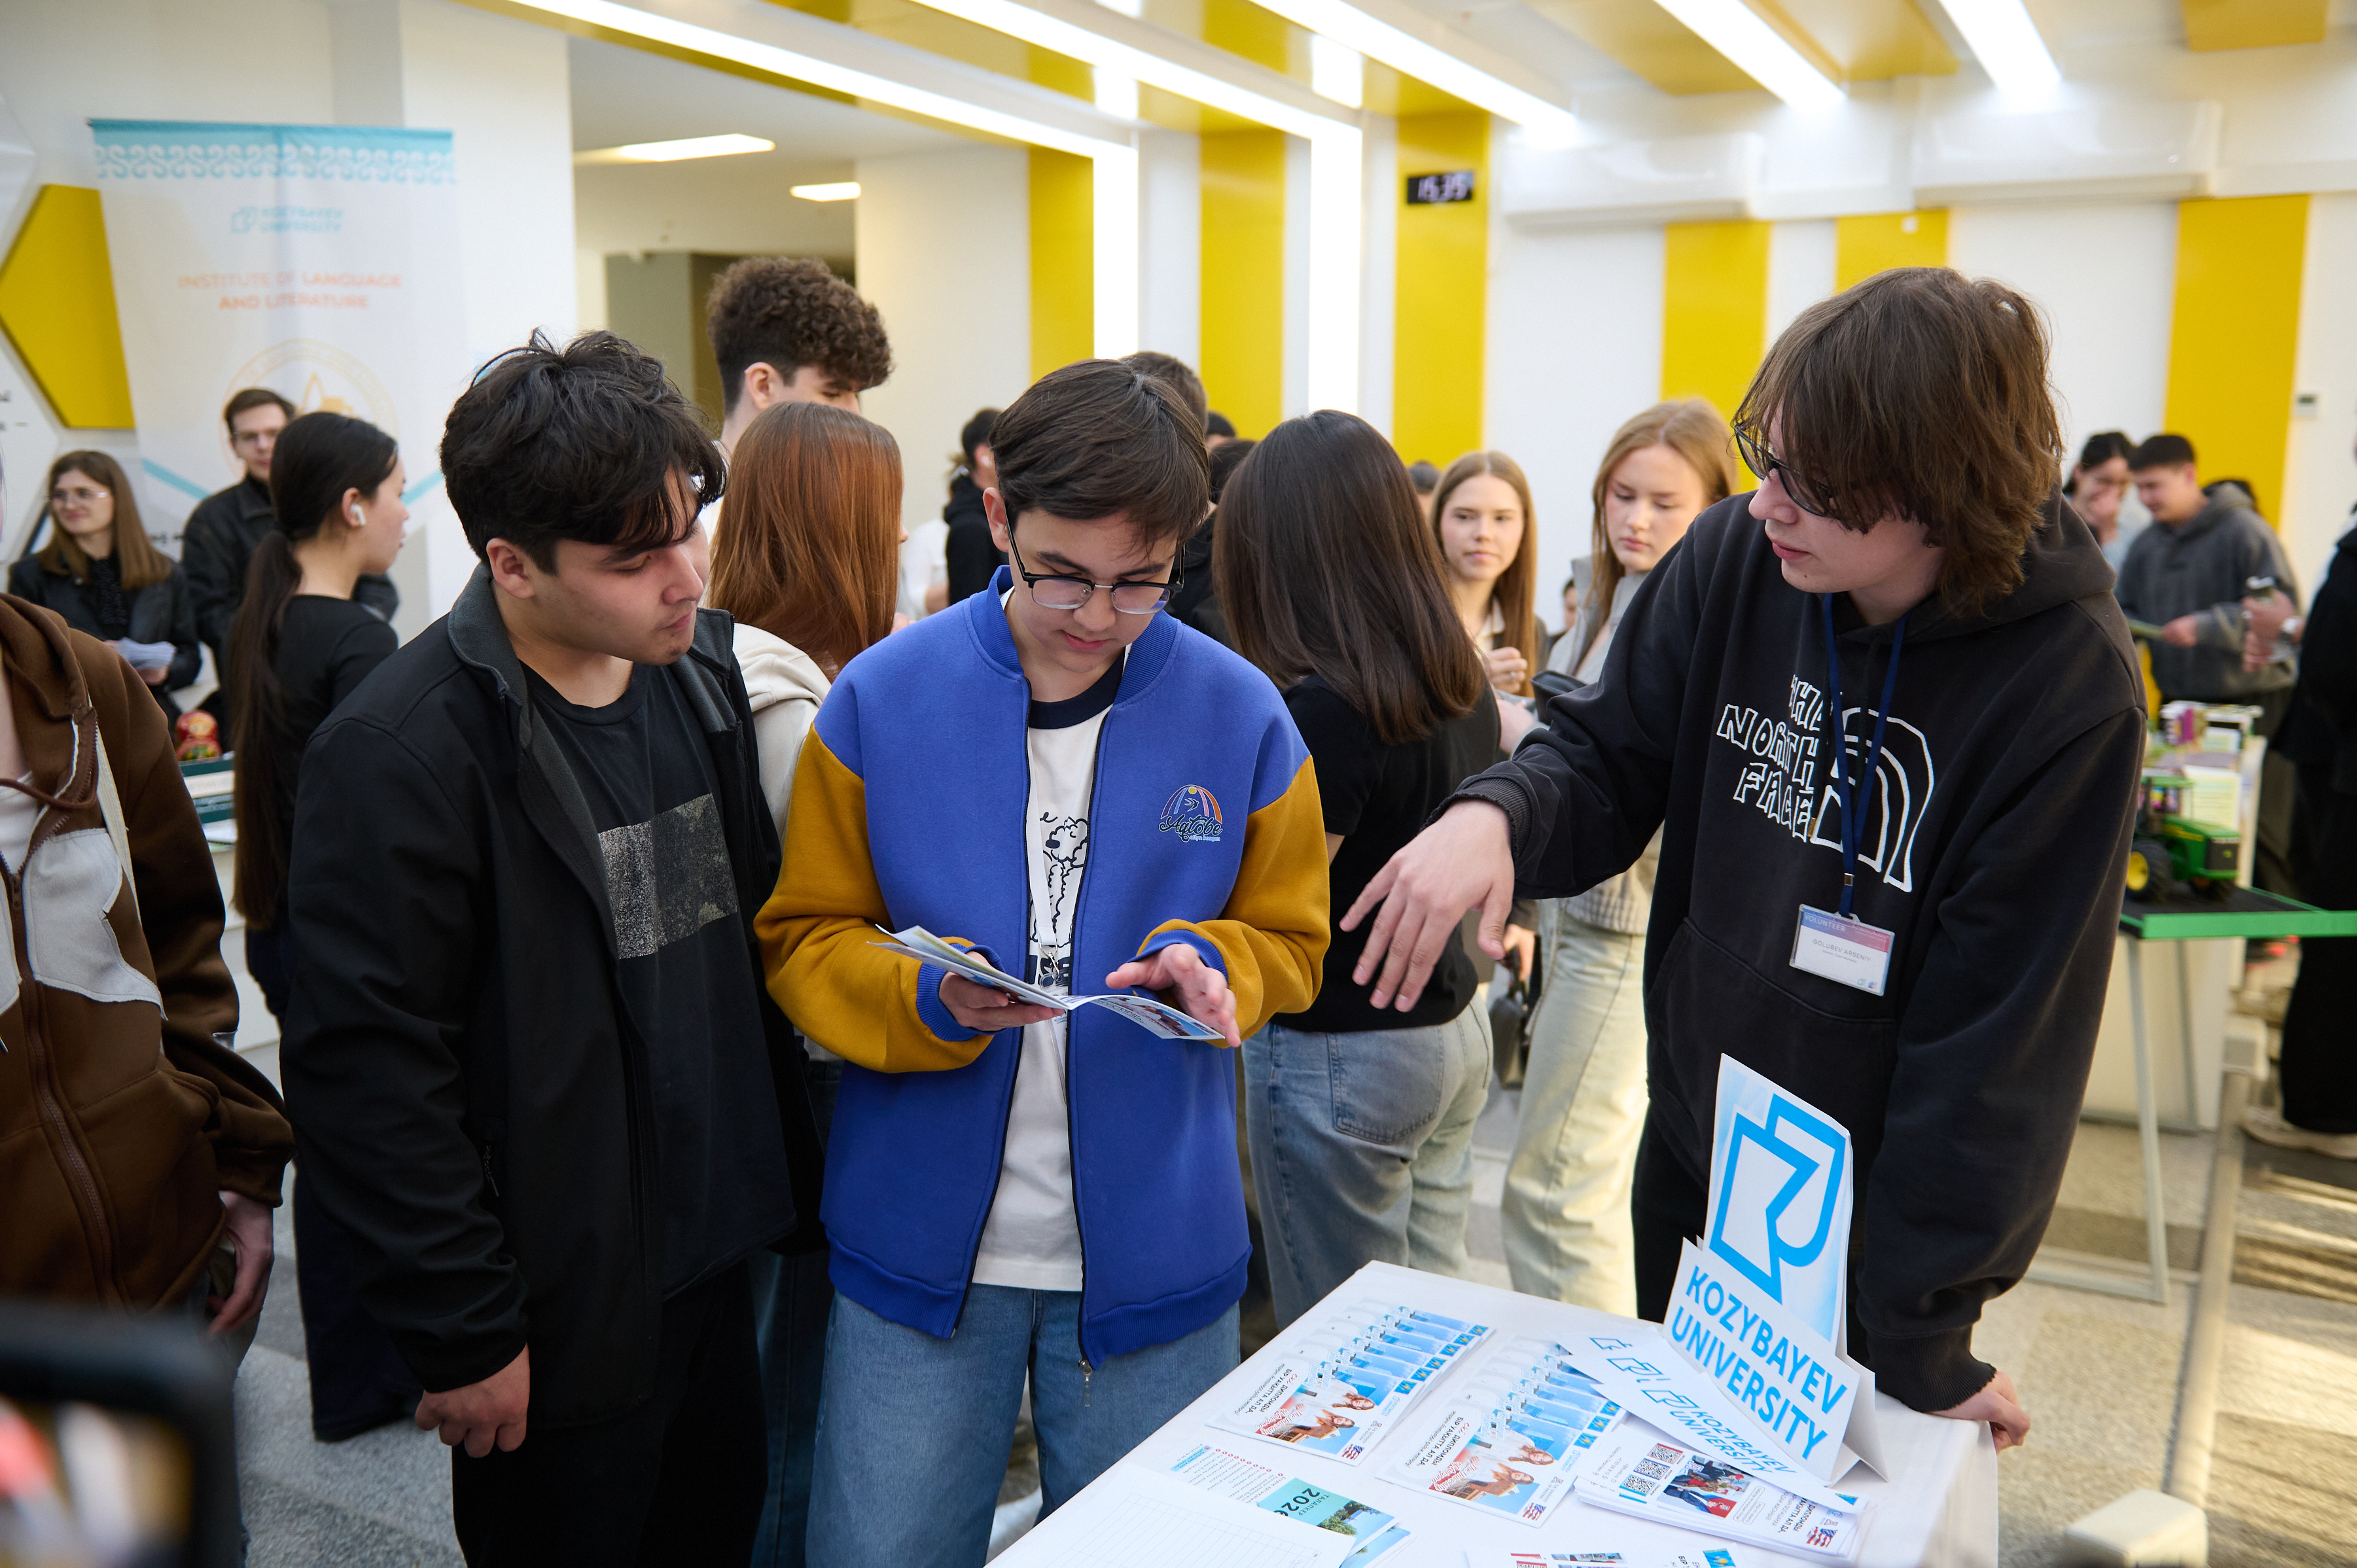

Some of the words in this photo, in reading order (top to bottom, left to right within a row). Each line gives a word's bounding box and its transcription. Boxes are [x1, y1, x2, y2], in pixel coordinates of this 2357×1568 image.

[178, 272, 270, 289] INSTITUTE
[276, 271, 294, 286] OF
[302, 271, 402, 288] LANGUAGE
[219, 296, 260, 310] AND
[265, 292, 368, 309] LITERATURE
[1805, 915, 1845, 932] VOLUNTEER
[1813, 939, 1843, 952] GOLUBEV
[1844, 950, 1871, 962] ARSENIY
[1686, 1264, 1848, 1414] KOZYBAYEV
[1283, 1368, 1292, 1377] БІР
[1672, 1306, 1828, 1460] UNIVERSITY
[1260, 1384, 1288, 1413] ДИПЛОМДЫ
[1262, 1377, 1284, 1398] УАҚЫТТА
[1454, 1416, 1464, 1426] БІР
[1432, 1426, 1455, 1450] УАҚЫТТА
[1670, 1410, 1774, 1473] UNIVERSITY
[1691, 1411, 1797, 1473] KOZYBAYEV
[1426, 1450, 1435, 1458] АЛ
[1432, 1434, 1461, 1465] ДИПЛОМДЫ
[1433, 1471, 1466, 1492] University
[1298, 1494, 1330, 1516] ТАЛАПКЕР
[1792, 1504, 1816, 1532] ДИПЛОМДЫ
[1678, 1556, 1688, 1565] БІР
